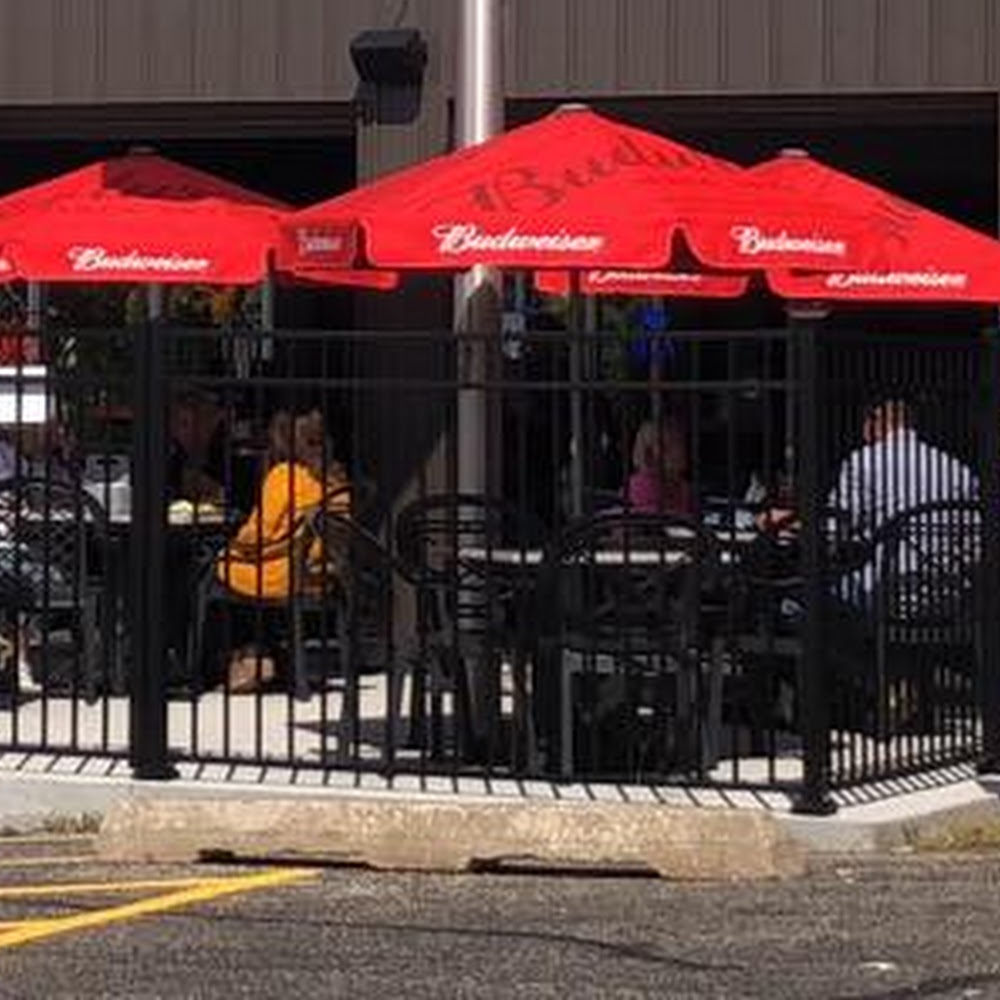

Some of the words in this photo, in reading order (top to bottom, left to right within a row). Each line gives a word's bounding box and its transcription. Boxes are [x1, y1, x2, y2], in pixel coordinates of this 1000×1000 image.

[432, 222, 605, 254] Budweiser
[730, 225, 847, 256] Budweiser
[66, 246, 211, 272] Budweiser
